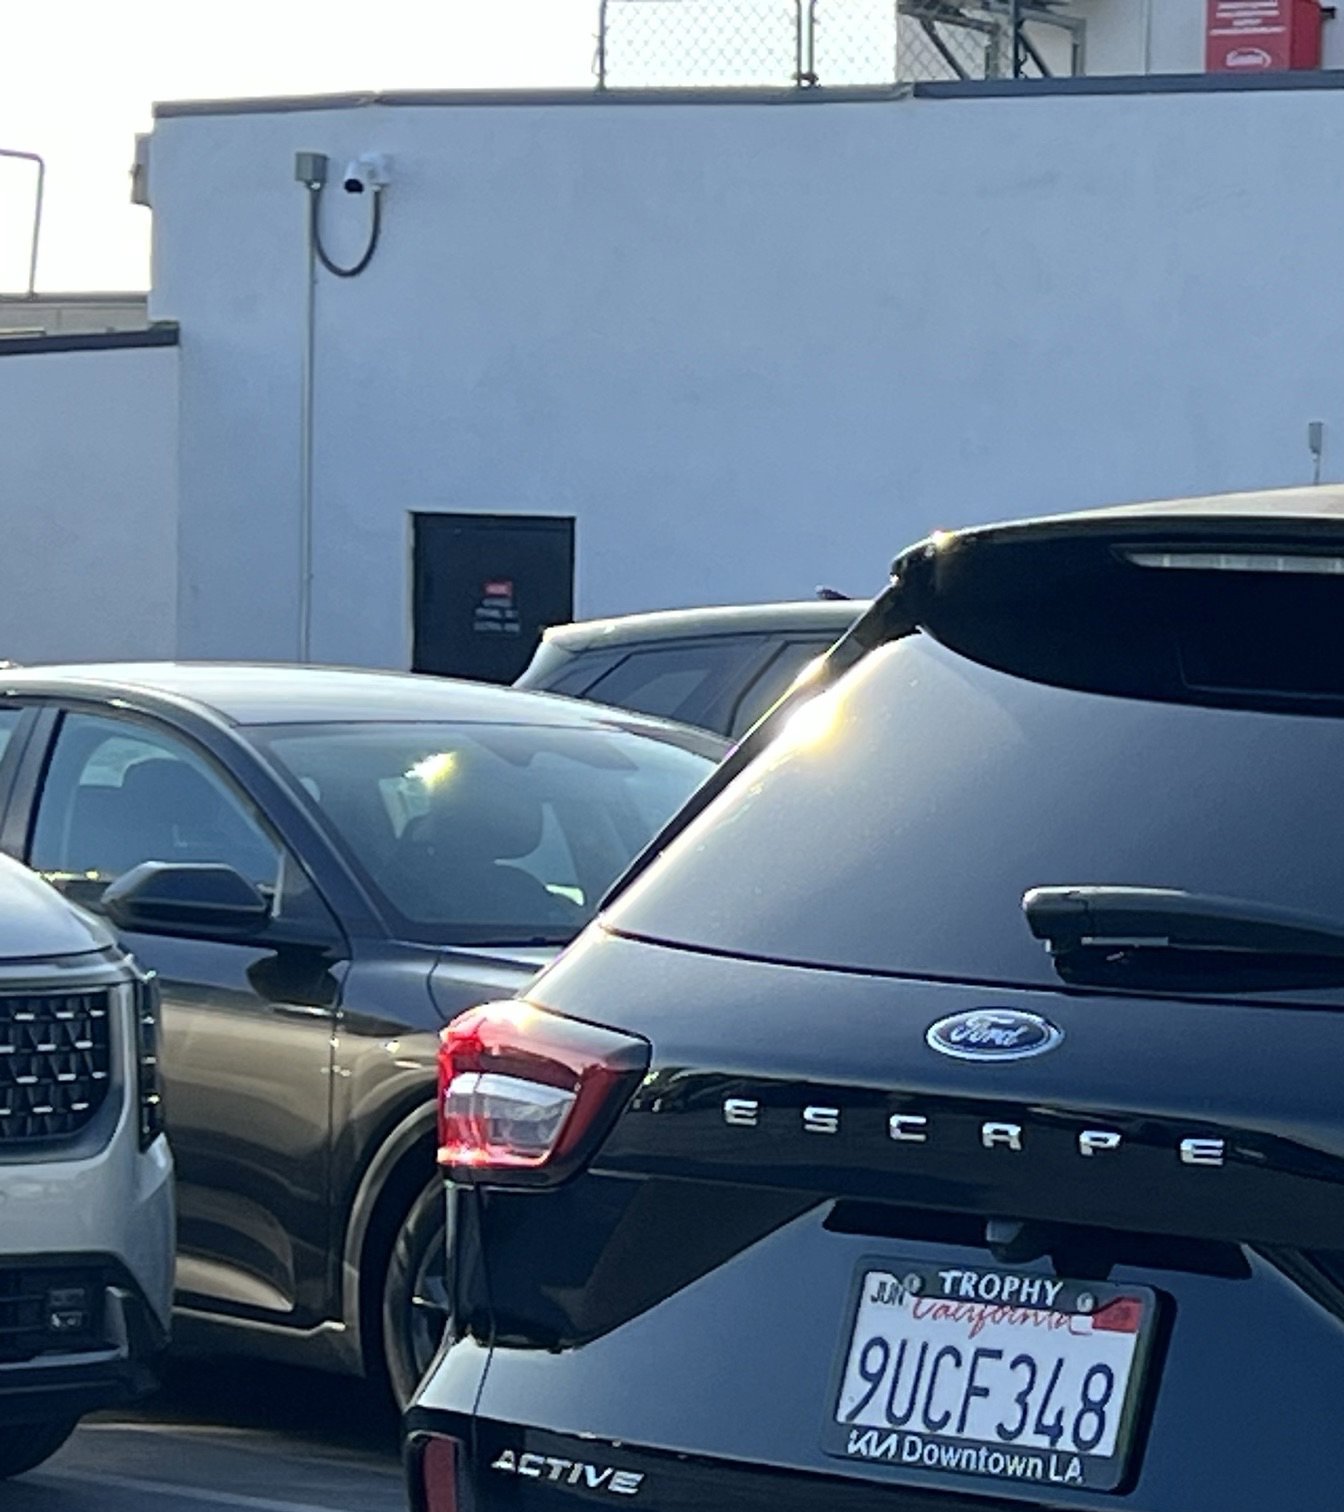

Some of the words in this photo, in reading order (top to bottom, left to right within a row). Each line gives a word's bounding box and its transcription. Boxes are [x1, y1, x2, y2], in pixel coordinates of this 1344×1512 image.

[949, 1015, 1031, 1047] Ford
[723, 1098, 1225, 1166] ESCAPE
[938, 1270, 1063, 1306] TROPHY
[846, 1336, 1114, 1451] 9UCF348
[491, 1450, 644, 1494] ACTIVE
[902, 1435, 1043, 1479] Downtown
[1049, 1454, 1084, 1484] LA
